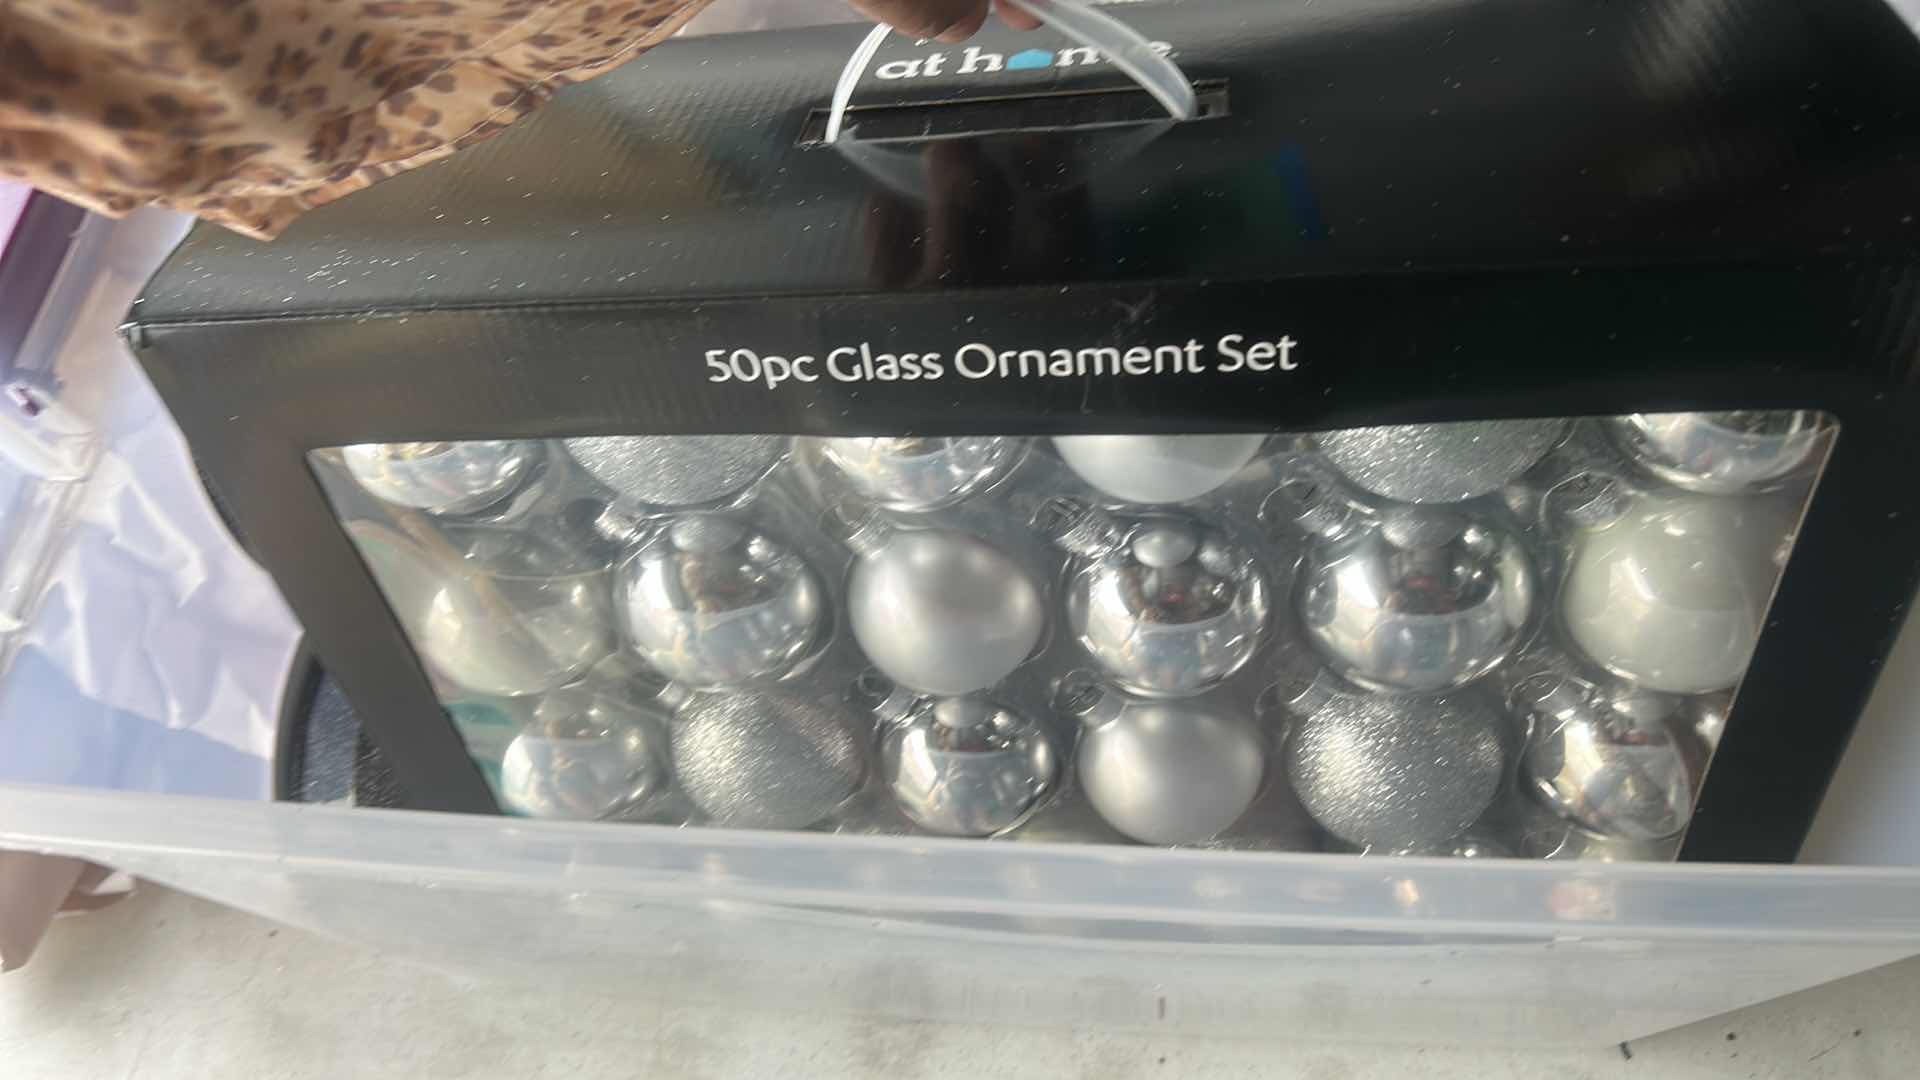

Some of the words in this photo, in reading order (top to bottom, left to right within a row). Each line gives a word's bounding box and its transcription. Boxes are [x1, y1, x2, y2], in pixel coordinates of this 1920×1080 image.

[874, 52, 950, 80] at
[704, 347, 819, 390] 50pc
[826, 342, 944, 382] Glass
[954, 336, 1205, 379] Ornament
[1216, 333, 1299, 372] Set
